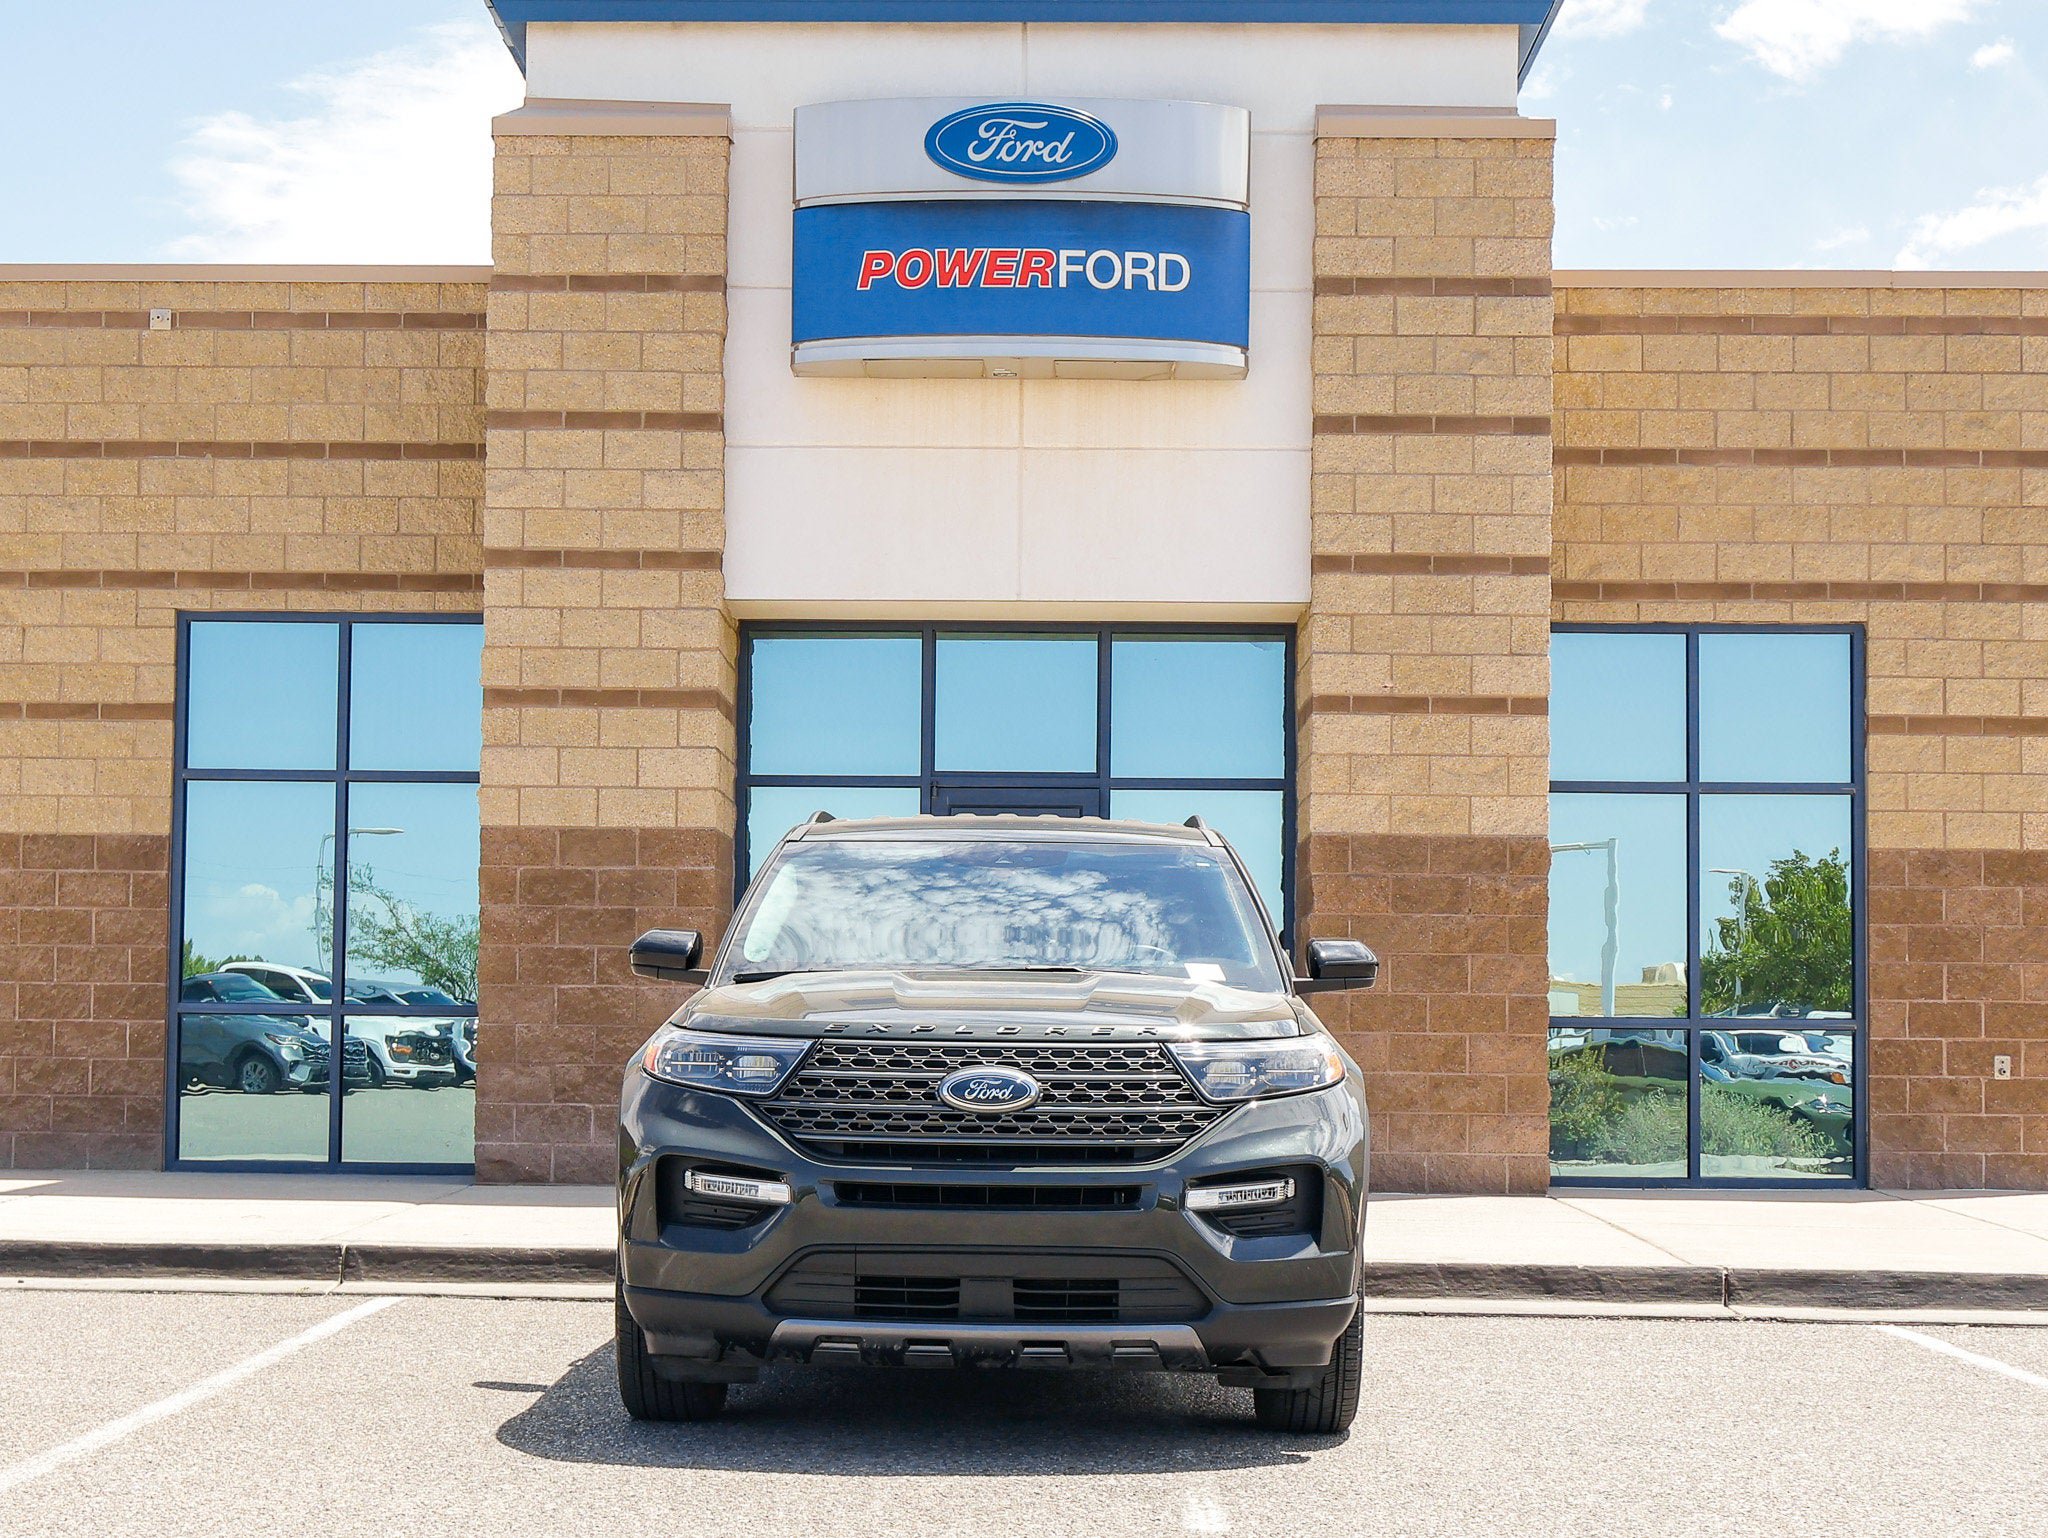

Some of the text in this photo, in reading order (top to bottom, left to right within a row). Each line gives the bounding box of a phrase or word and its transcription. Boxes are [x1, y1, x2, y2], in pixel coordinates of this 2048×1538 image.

[967, 118, 1076, 164] Ford
[823, 1022, 1160, 1036] EXPLORER
[964, 1079, 1015, 1100] Ford
